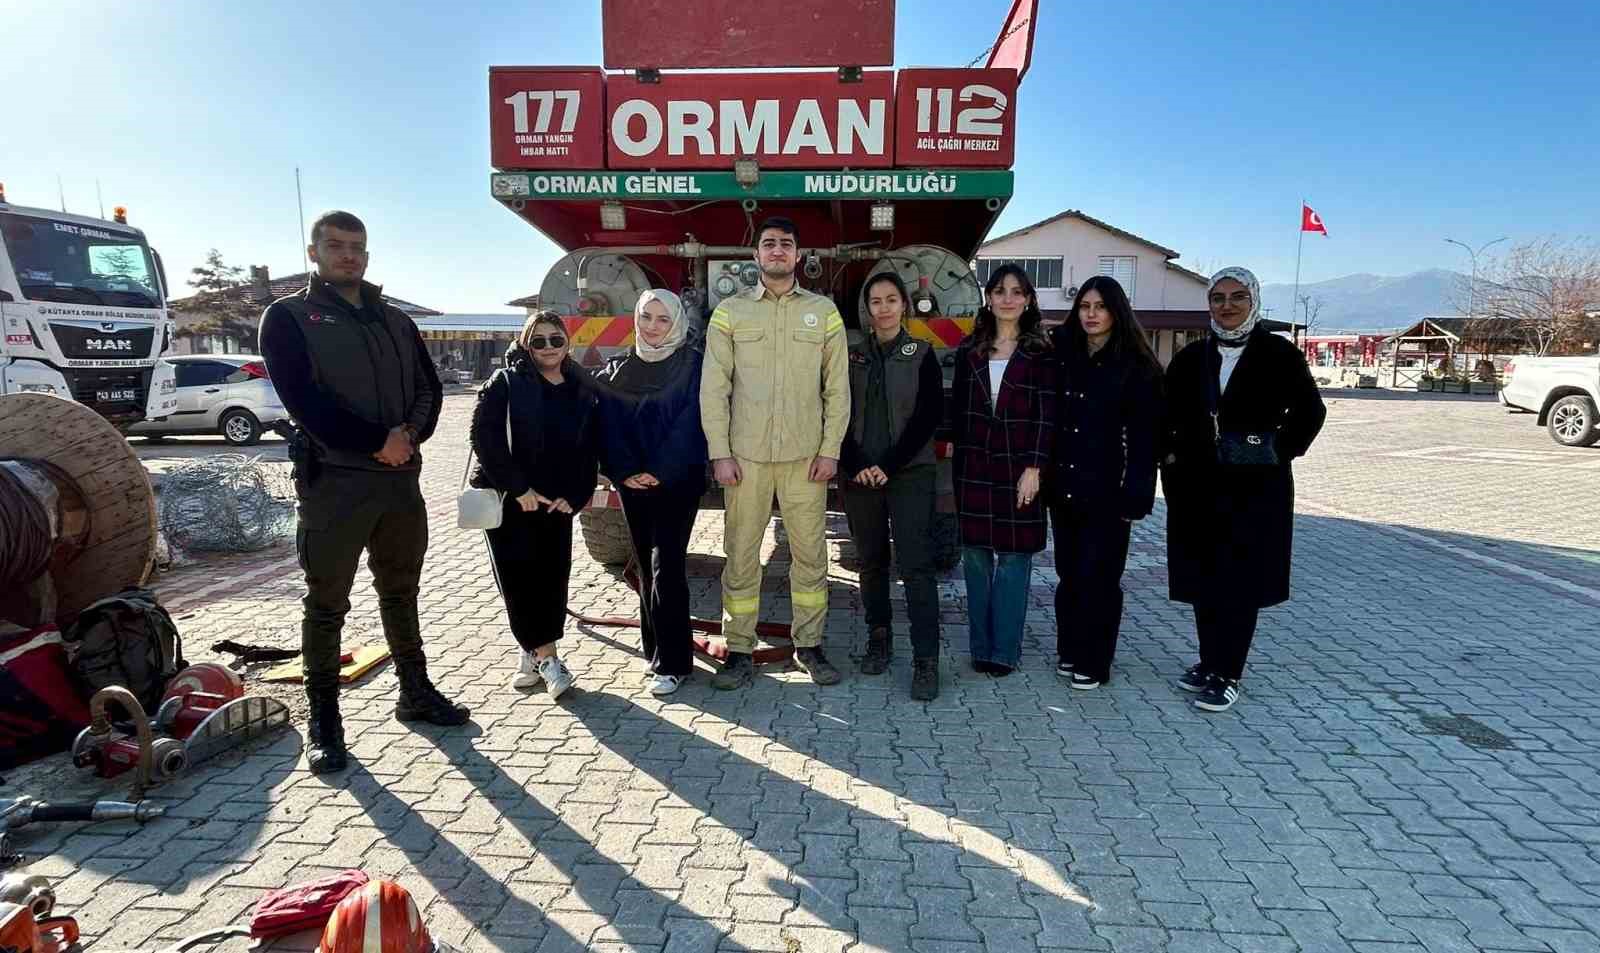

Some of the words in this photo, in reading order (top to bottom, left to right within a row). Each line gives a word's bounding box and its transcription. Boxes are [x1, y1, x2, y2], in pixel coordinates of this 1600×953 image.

[504, 90, 580, 133] 177
[916, 84, 1007, 135] 112
[611, 99, 886, 157] ORMAN
[515, 135, 543, 144] ORMAN
[545, 134, 573, 143] YANGIN
[937, 136, 962, 152] ÇAĞRI
[964, 137, 1000, 151] MERKEZİ
[520, 146, 545, 156] İHBAR
[546, 146, 569, 155] HATTI
[533, 176, 617, 193] ORMAN
[624, 176, 701, 193] GENEL
[804, 172, 957, 193] MÜDÜRLÜĞÜ
[86, 338, 132, 350] MAN
